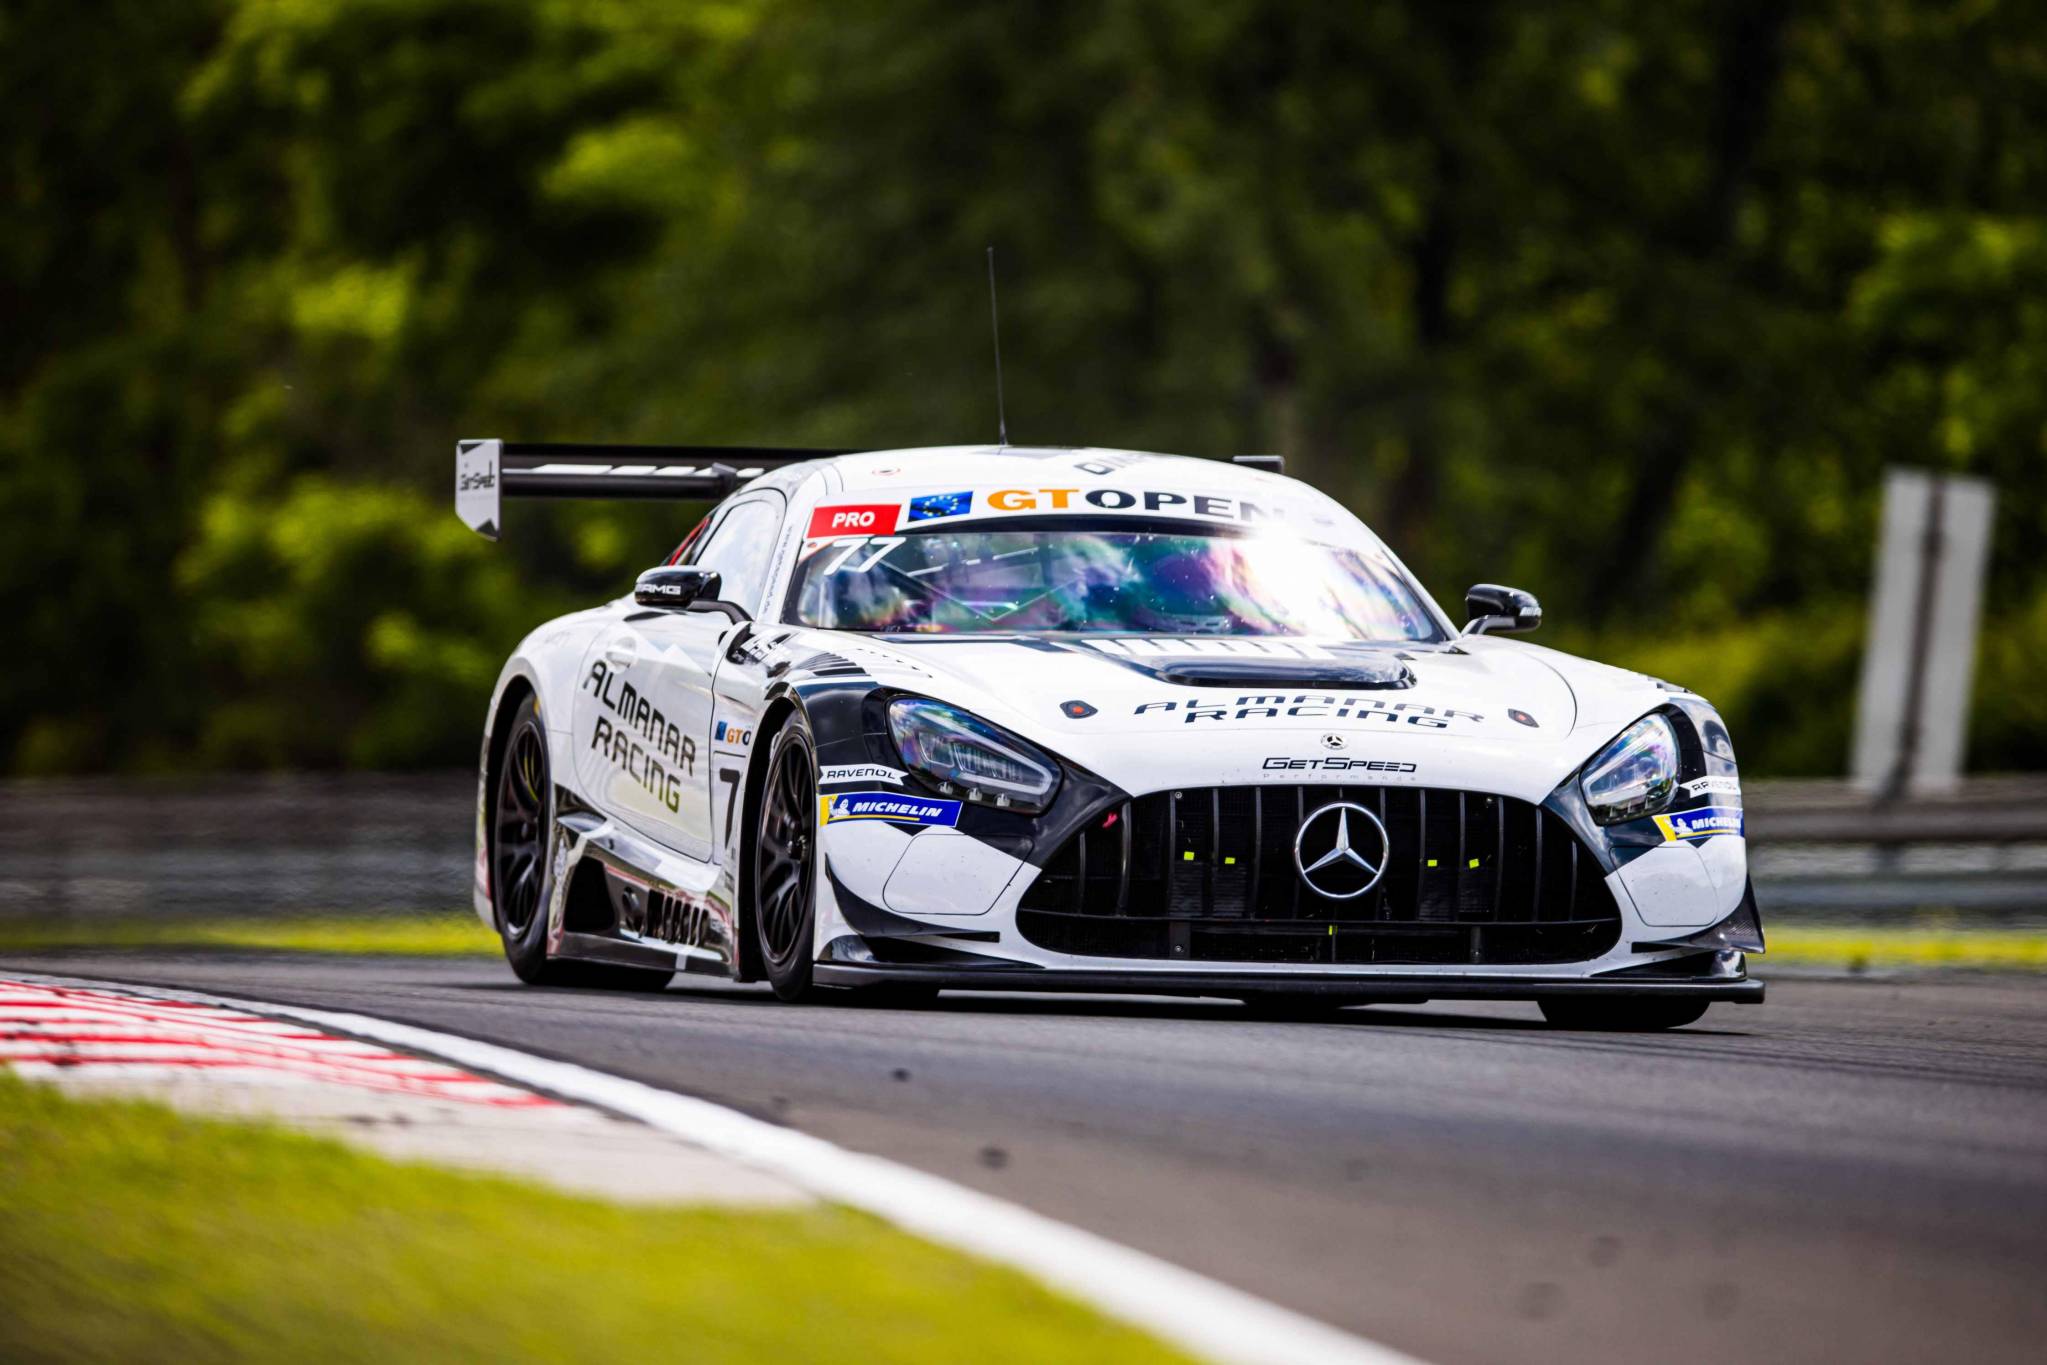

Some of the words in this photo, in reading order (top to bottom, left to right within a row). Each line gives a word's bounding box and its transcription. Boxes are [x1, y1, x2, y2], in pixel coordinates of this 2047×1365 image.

[832, 512, 875, 528] PRO
[824, 537, 906, 576] 77
[640, 583, 681, 595] AMG
[582, 660, 696, 776] ALMANAR
[1134, 695, 1485, 722] ALMANAR
[1184, 706, 1449, 728] RACING
[591, 716, 681, 813] RACING
[826, 768, 896, 780] RAVENOL
[852, 801, 943, 817] MICHELIN
